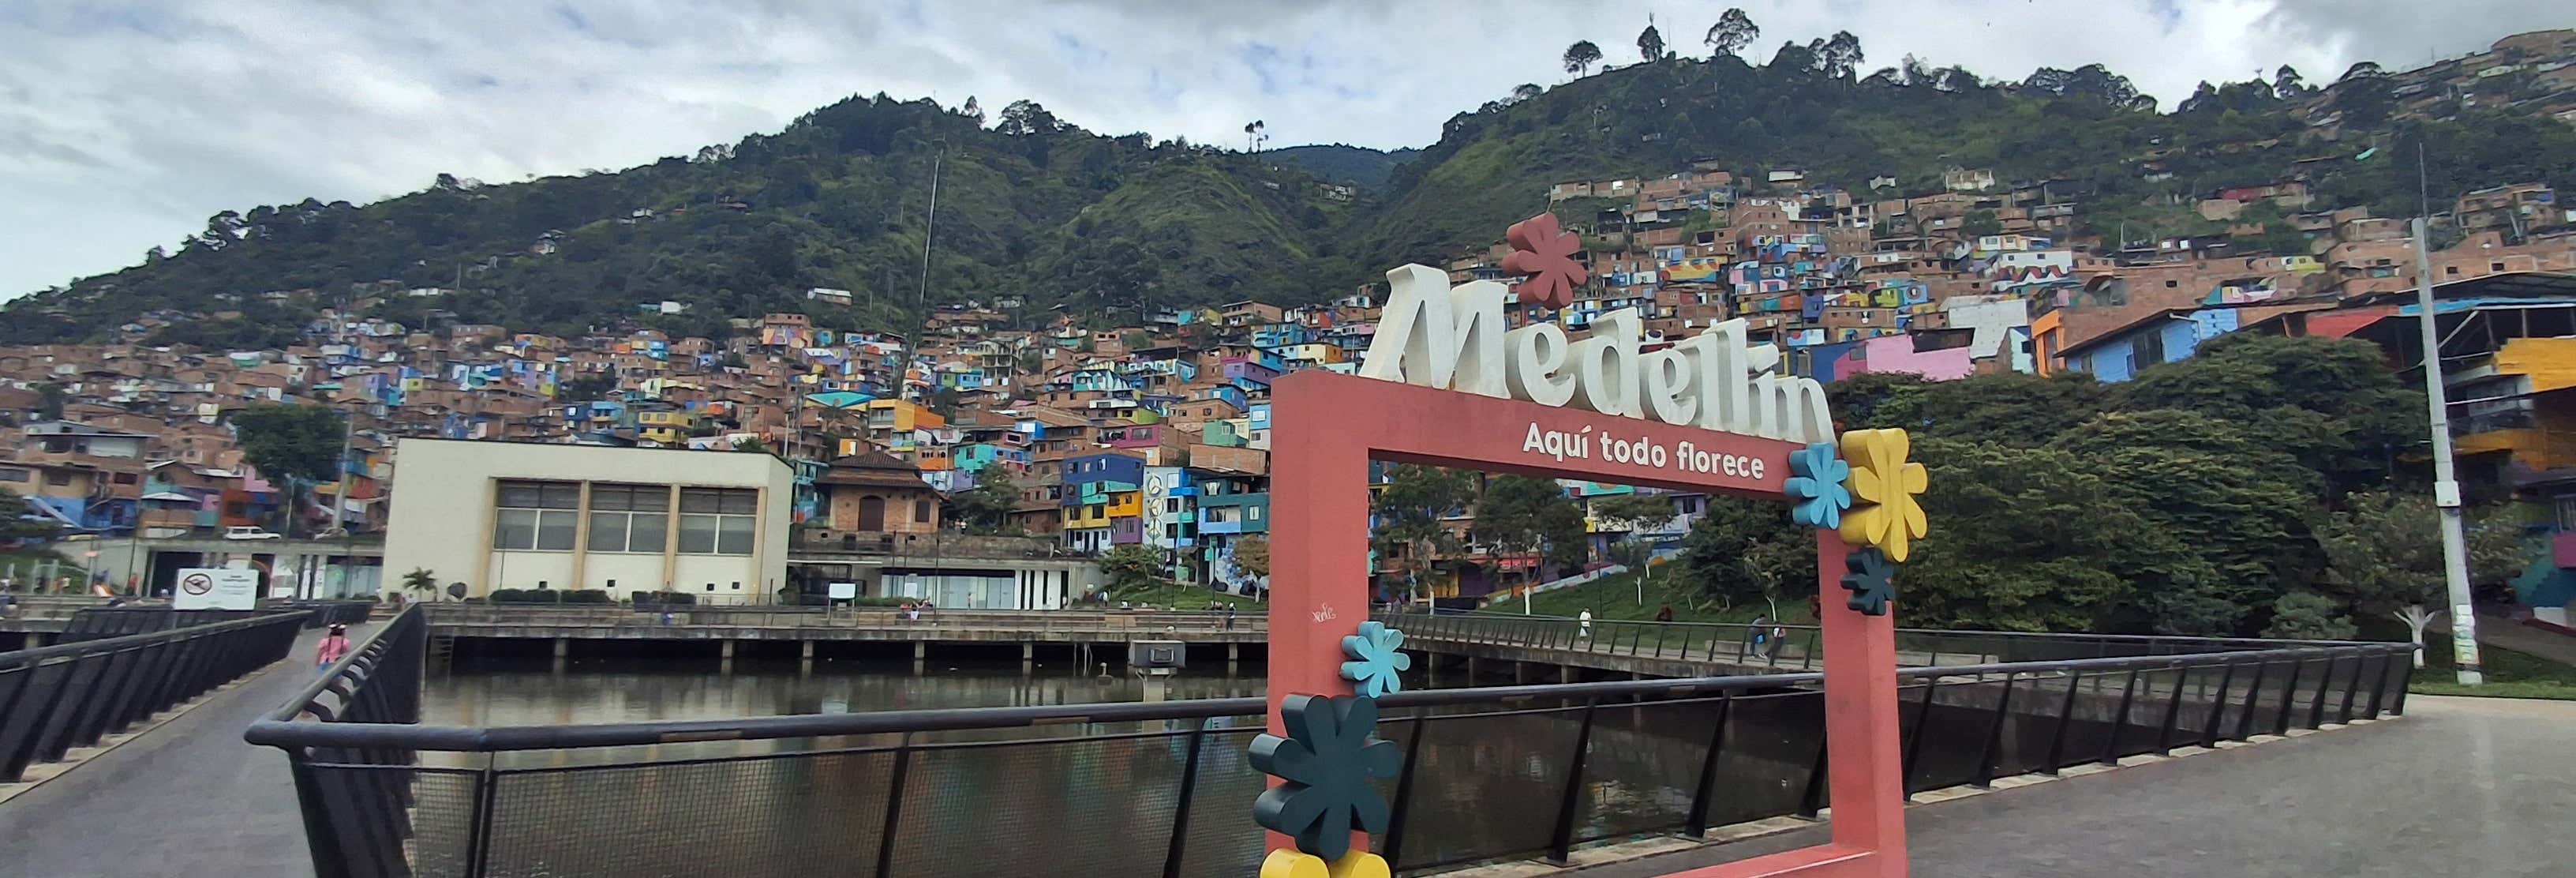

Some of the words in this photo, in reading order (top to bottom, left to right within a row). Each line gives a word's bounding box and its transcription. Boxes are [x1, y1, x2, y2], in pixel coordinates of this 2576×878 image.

[1358, 263, 1835, 445] Medellín
[1522, 422, 1592, 462] Aquí
[1600, 431, 1667, 467] todo
[1676, 441, 1764, 479] florece
